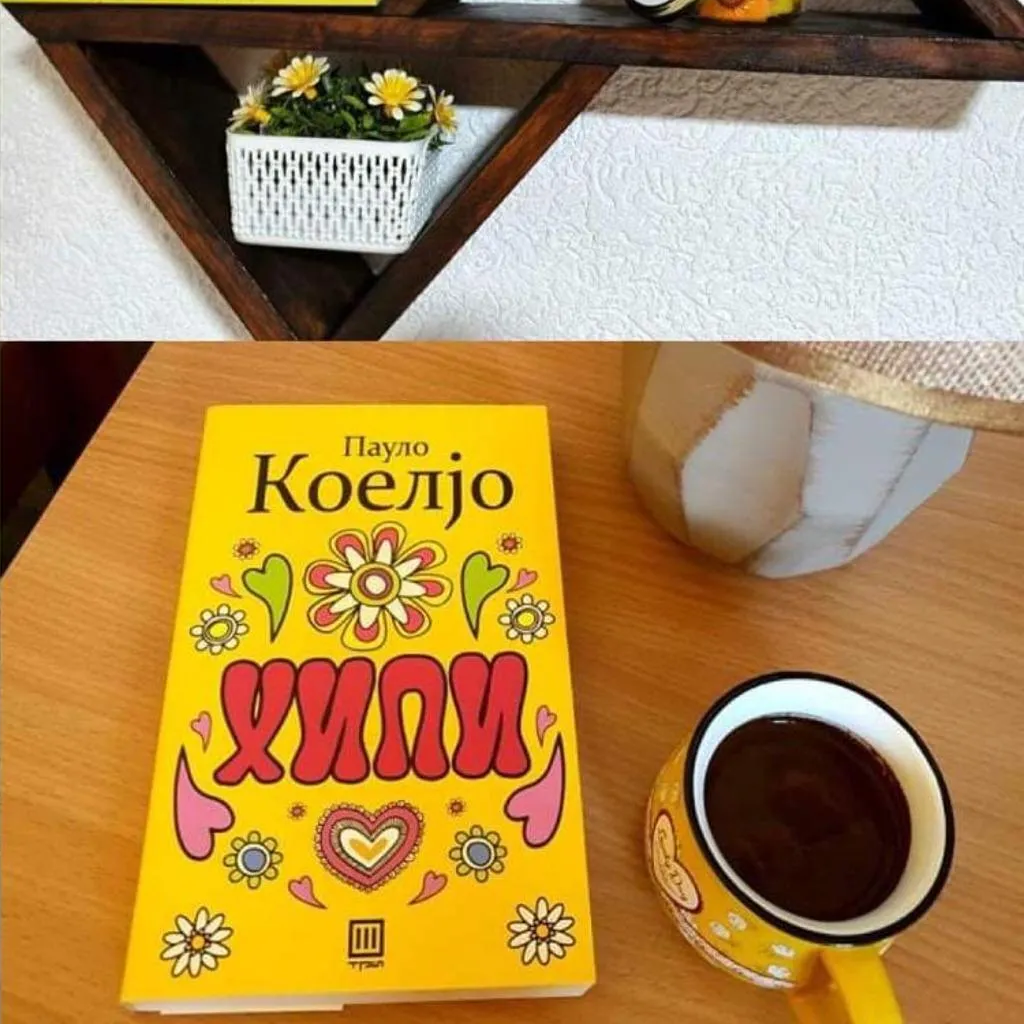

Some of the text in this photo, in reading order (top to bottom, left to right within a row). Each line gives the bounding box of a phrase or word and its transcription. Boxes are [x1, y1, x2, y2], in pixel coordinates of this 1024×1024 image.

[343, 434, 429, 461] Пауло
[246, 451, 514, 529] Коелјо
[212, 651, 532, 786] ХИПИ
